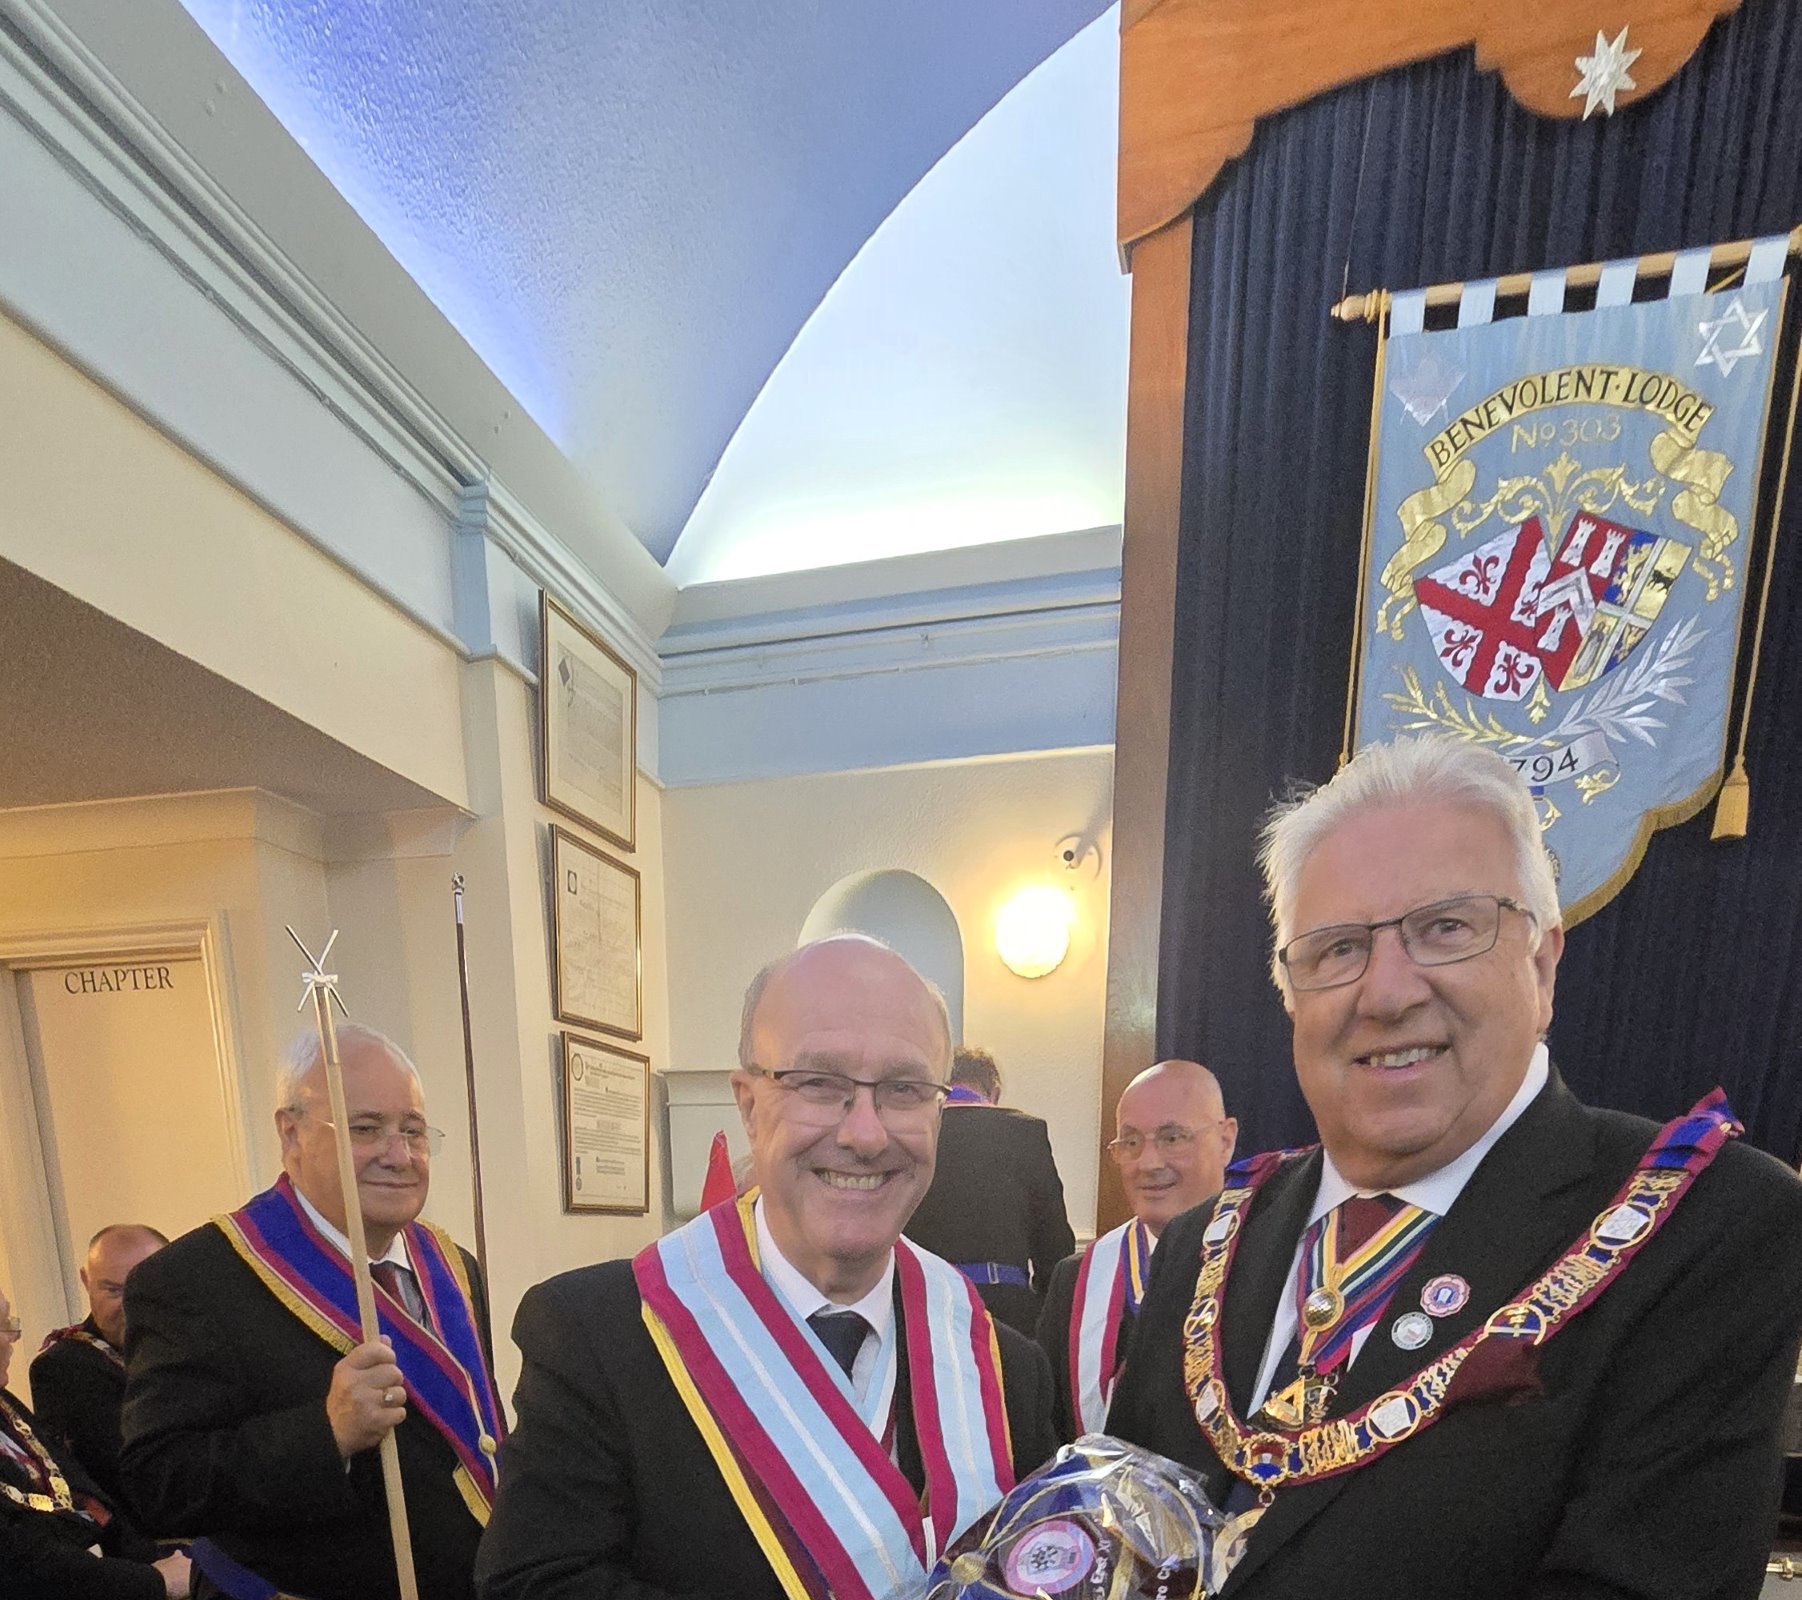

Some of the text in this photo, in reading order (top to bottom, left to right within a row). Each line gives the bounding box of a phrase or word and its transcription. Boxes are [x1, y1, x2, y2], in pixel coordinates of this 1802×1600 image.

[1430, 368, 1713, 468] BENEVOLENT LODGE
[1560, 414, 1622, 448] 303
[1508, 746, 1580, 783] 794
[64, 965, 174, 995] CHAPTER
